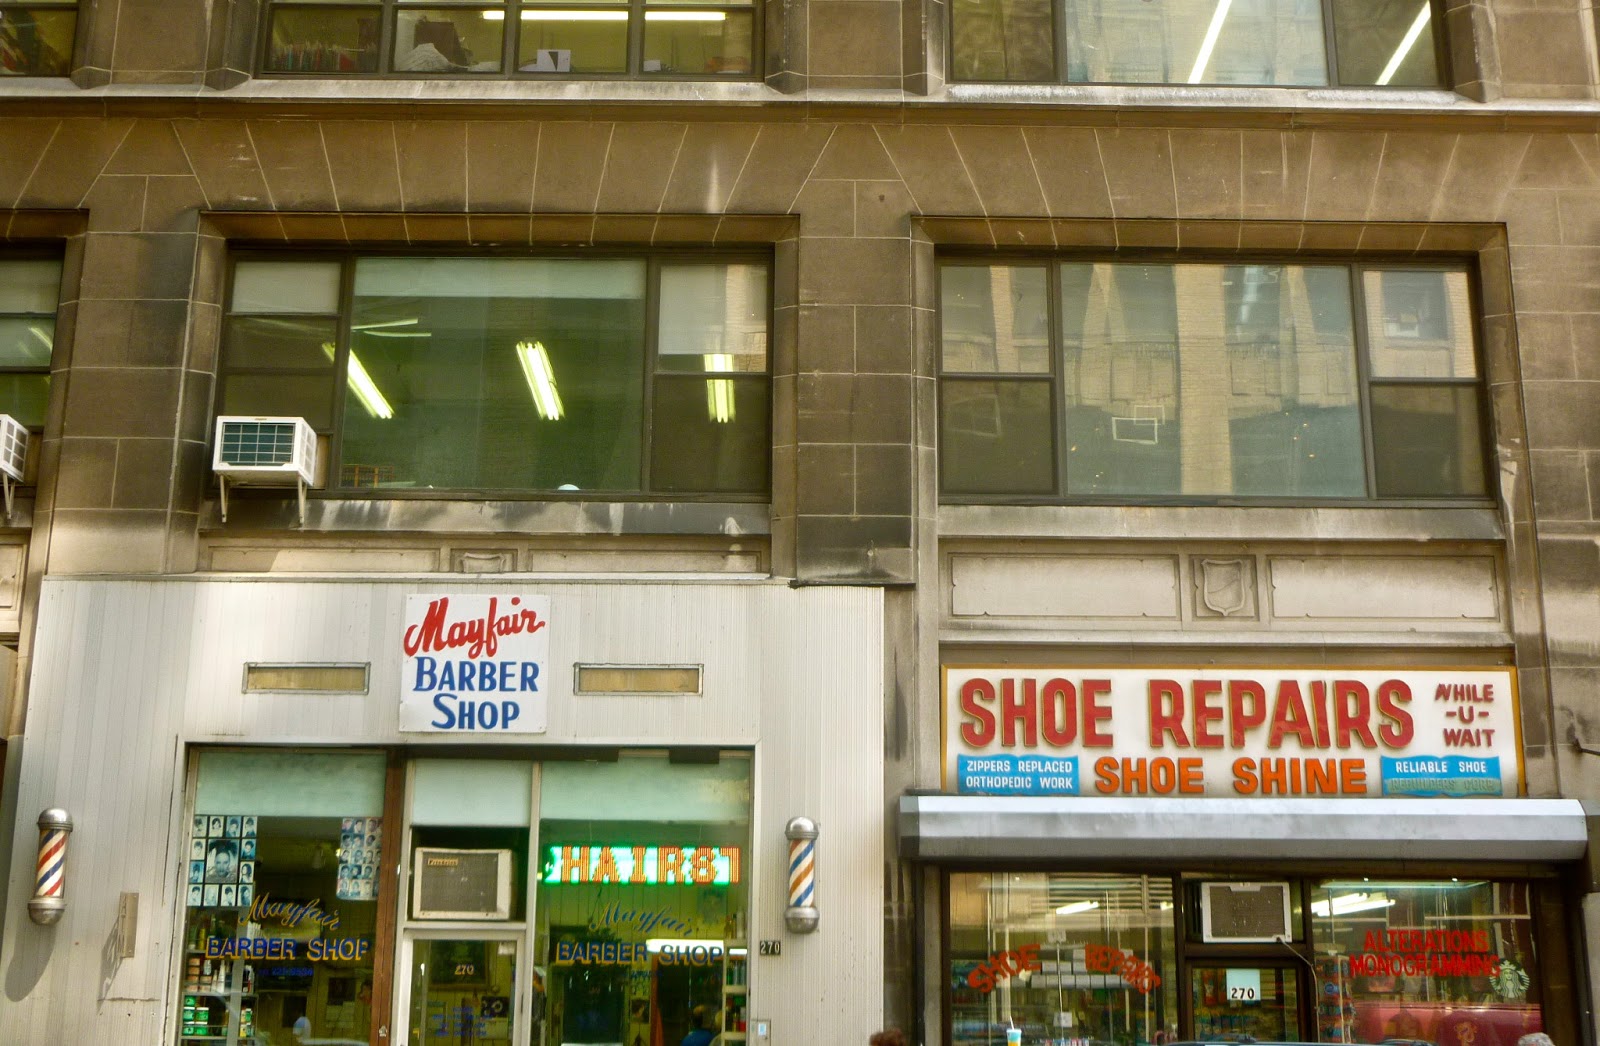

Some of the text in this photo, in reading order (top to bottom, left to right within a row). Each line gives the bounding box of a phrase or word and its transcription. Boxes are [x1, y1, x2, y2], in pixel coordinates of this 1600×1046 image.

[403, 597, 546, 660] Mayfair
[412, 656, 540, 692] BARBER
[1434, 683, 1494, 703] WHILE
[431, 692, 520, 731] SHOP
[960, 677, 1414, 749] SHOE REPAIRS
[1443, 728, 1495, 747] WAIT
[966, 759, 1073, 773] ZIPPERS REPLACED
[1094, 756, 1368, 795] SHOE SHINE
[1395, 760, 1487, 774] RELIABLE SHOE
[965, 776, 1073, 790] ORTHOPEDIC WORK
[238, 892, 341, 931] Mayfair
[589, 900, 694, 937] Mayfair
[205, 937, 371, 962] BARBER SHOP
[761, 941, 780, 954] 270
[1363, 929, 1488, 953] ALTERATIONS
[556, 942, 724, 967] BARBER SHOP
[1350, 954, 1500, 977] MONOGRAMMING
[454, 964, 474, 976] 270
[967, 943, 1041, 994] SHOE
[1231, 987, 1255, 1000] 270
